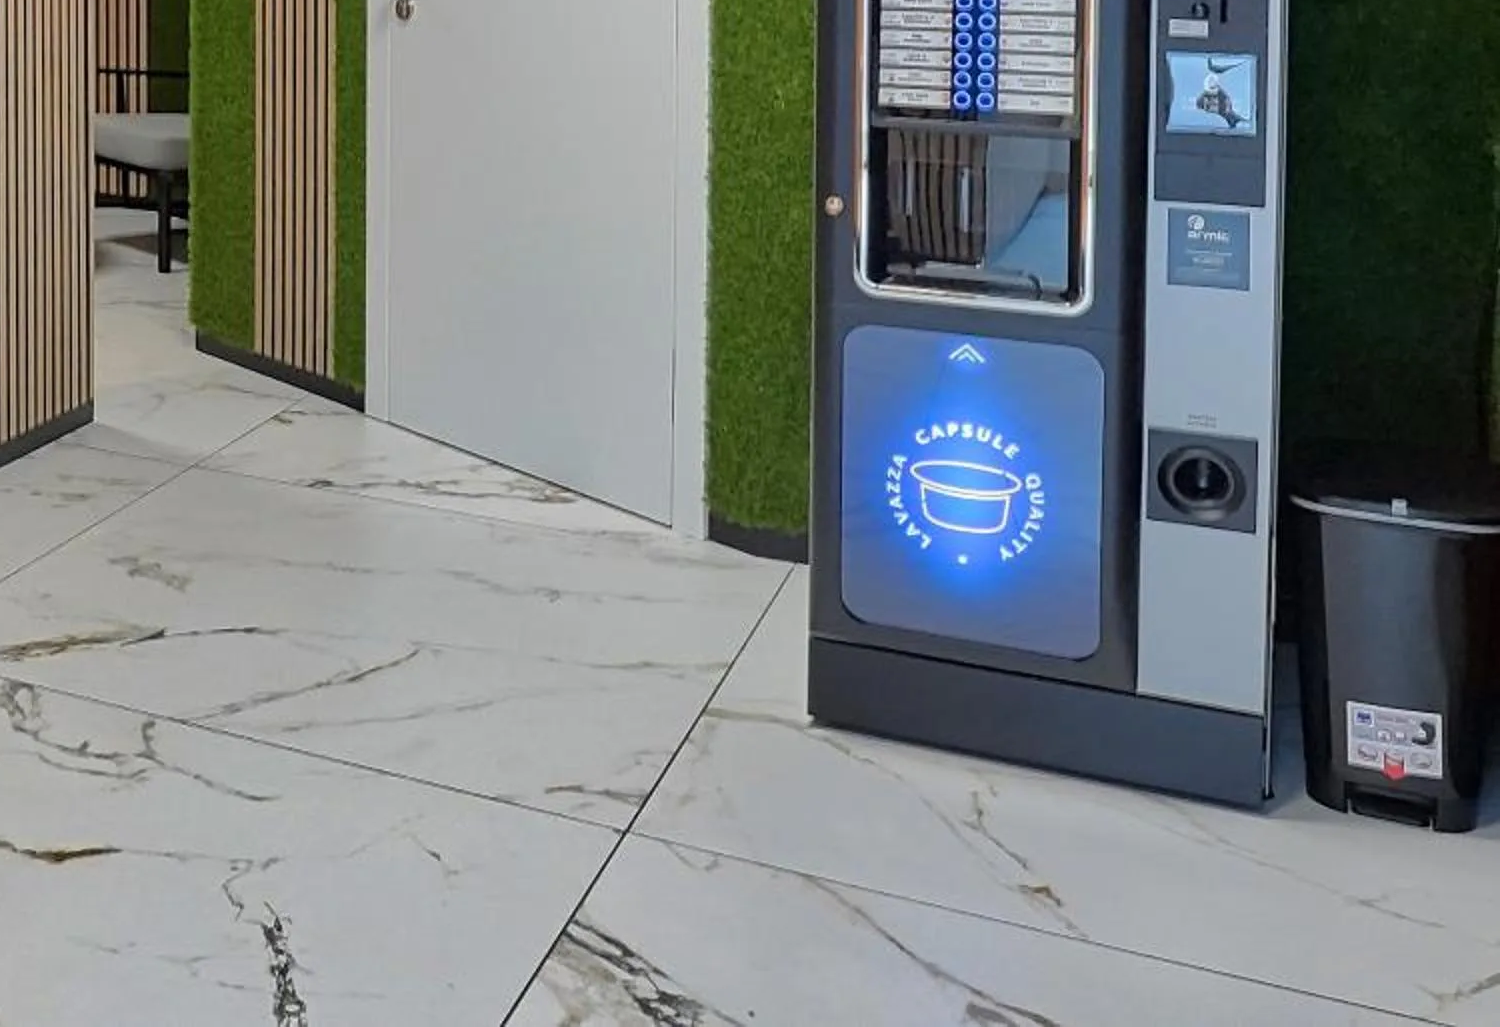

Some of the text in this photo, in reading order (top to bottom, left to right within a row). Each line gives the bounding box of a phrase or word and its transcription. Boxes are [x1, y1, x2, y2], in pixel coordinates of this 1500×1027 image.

[915, 422, 1020, 459] CAPSULE
[885, 454, 932, 550] LAVAZZA
[1000, 473, 1046, 561] QUALITY
